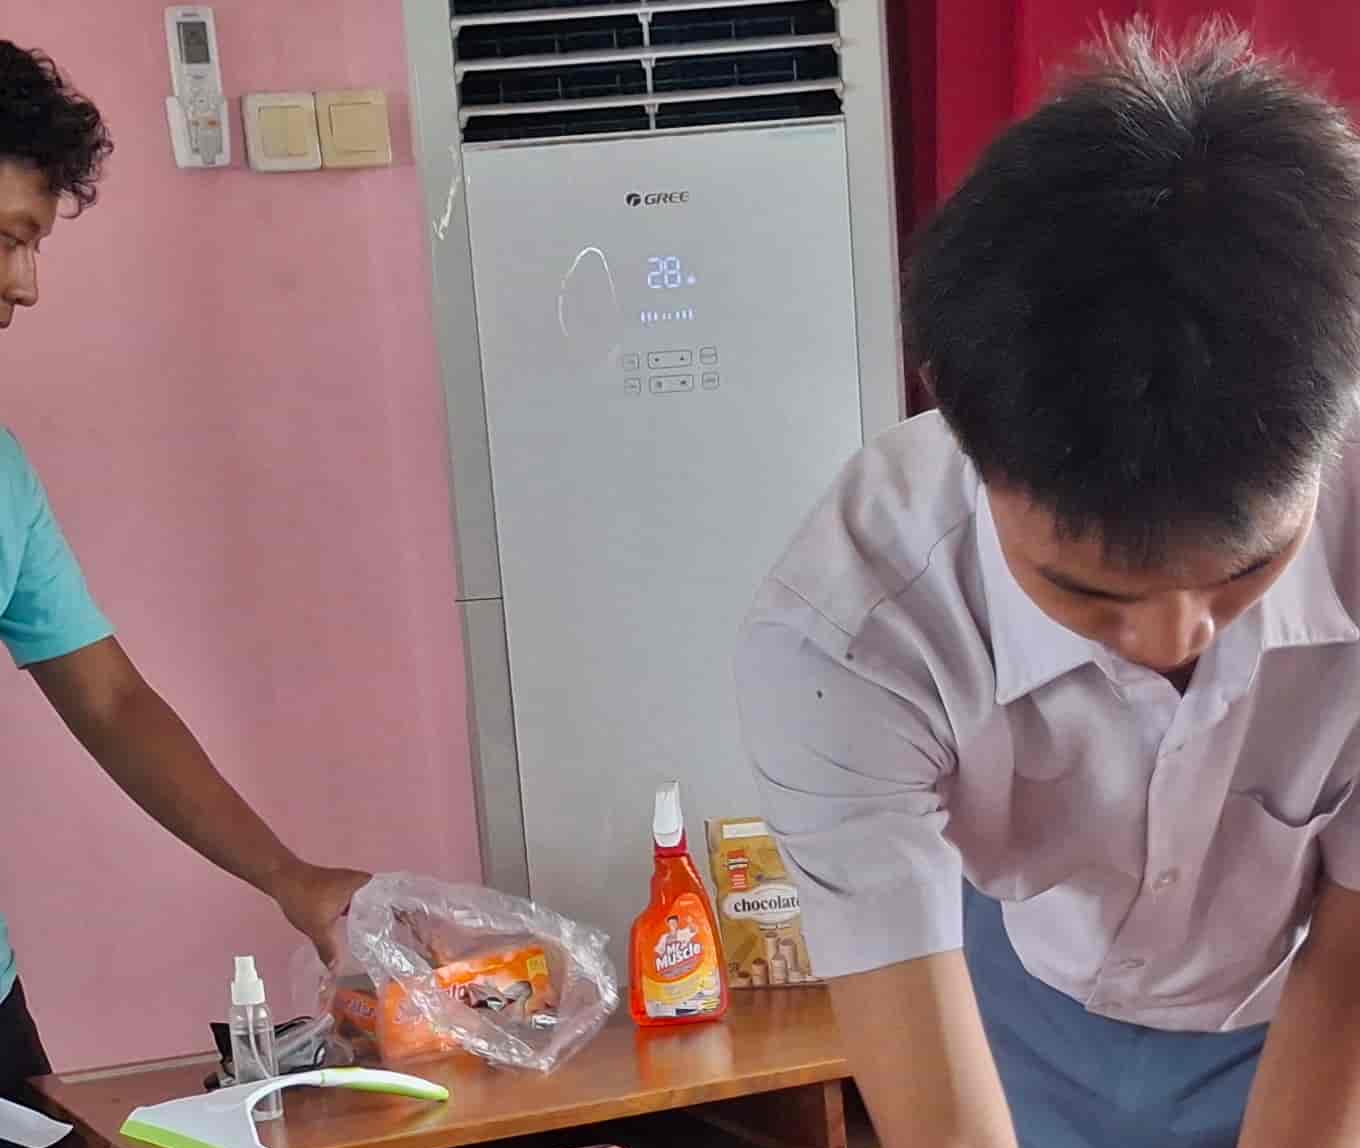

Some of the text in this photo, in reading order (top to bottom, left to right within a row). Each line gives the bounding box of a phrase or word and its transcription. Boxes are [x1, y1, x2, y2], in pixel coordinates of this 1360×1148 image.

[644, 192, 689, 206] GREE
[647, 256, 681, 289] 28
[655, 943, 703, 971] Muscle
